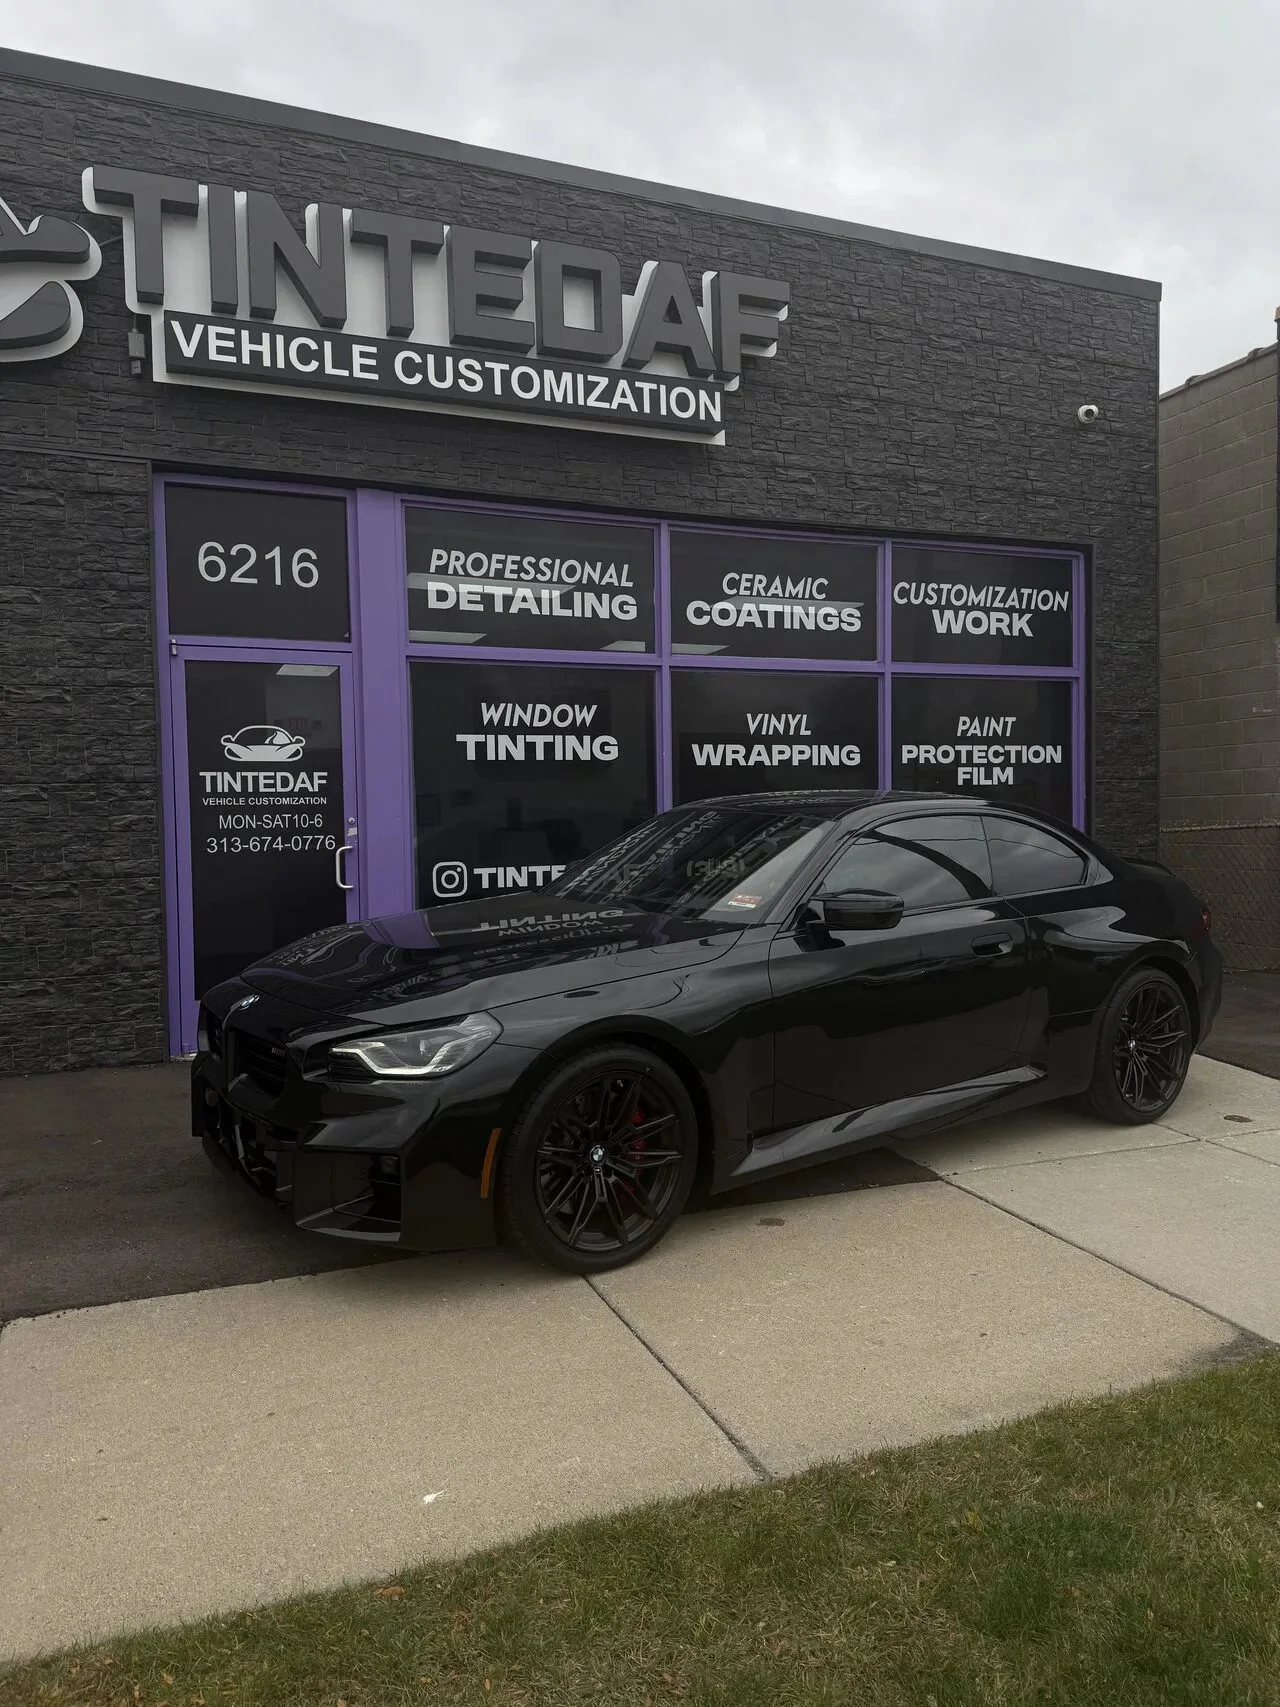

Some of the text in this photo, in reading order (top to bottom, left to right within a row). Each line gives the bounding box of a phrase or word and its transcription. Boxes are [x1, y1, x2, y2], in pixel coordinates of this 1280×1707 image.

[90, 165, 790, 382] TINTEDAF
[171, 320, 723, 423] VEHICLE CUSTOMIZATION
[197, 541, 319, 588] 6216
[429, 548, 634, 588] PROFESSIONAL
[722, 572, 829, 600] CERAMIC
[893, 581, 1070, 613] CUSTOMIZATION
[427, 581, 638, 621] DETAILING
[686, 600, 862, 633] COATINGS
[932, 609, 1034, 637] WORK
[480, 702, 598, 728] WINDOW
[746, 712, 812, 736] VINYL
[956, 716, 1017, 737] PAINT
[456, 734, 619, 762] TINTING
[691, 744, 861, 767] WRAPPING
[901, 744, 1062, 764] PROTECTION
[199, 771, 328, 793] TINTEDAF
[957, 766, 1014, 786] FILM
[202, 796, 327, 806] VEHICLE CUSTOMIZATION
[206, 834, 336, 854] 313-674-0776
